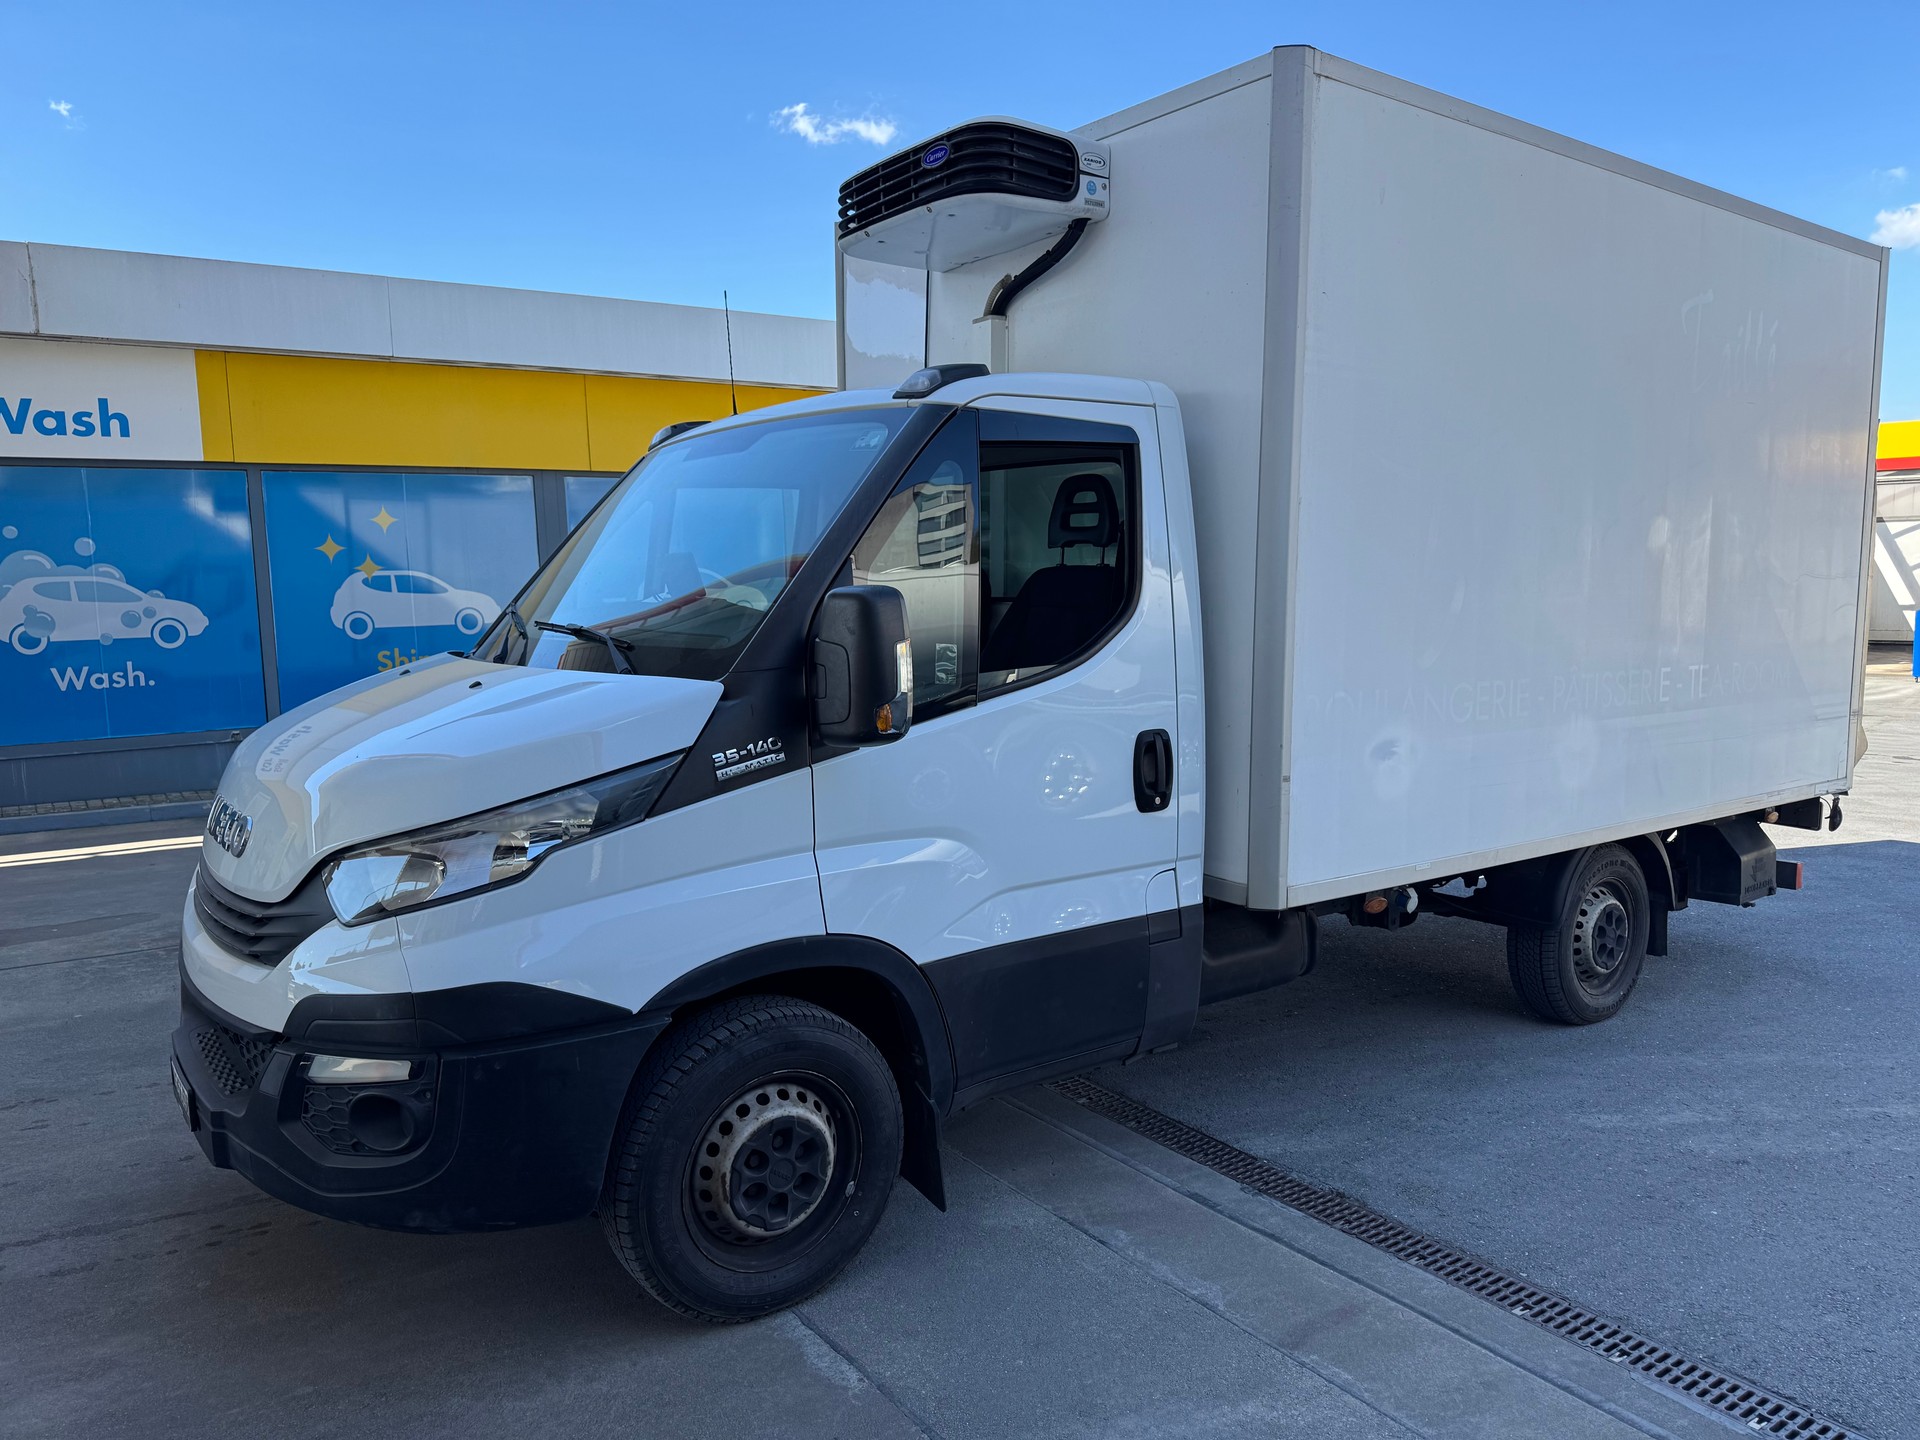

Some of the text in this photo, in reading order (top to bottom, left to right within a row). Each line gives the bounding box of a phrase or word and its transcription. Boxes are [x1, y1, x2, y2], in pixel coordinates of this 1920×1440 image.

[926, 150, 946, 163] Carrier
[377, 647, 430, 672] Shi
[49, 661, 155, 692] Wash.
[1552, 665, 1672, 713] PÂTISSERIE
